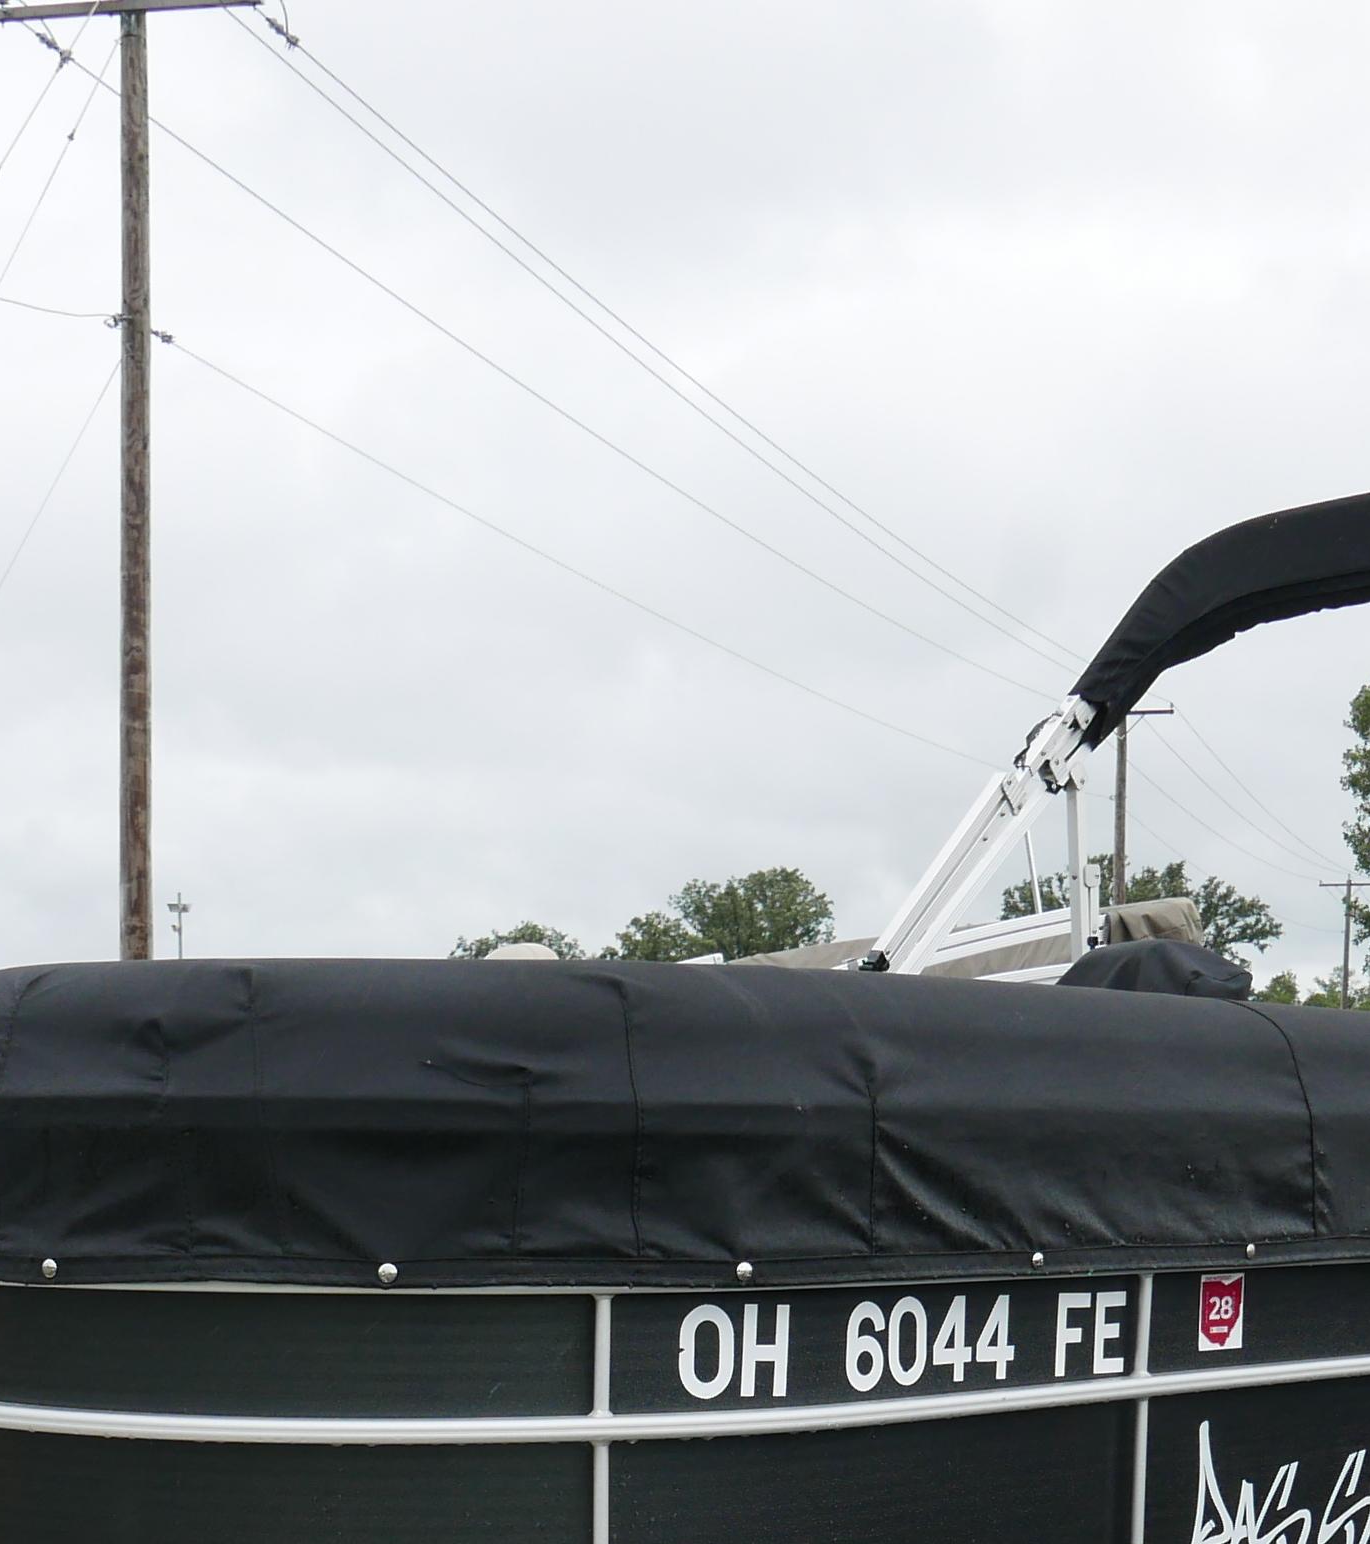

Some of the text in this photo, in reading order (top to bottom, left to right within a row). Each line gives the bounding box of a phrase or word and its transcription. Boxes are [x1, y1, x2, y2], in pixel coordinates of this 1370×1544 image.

[1209, 1296, 1233, 1320] 28
[678, 1291, 1126, 1399] OH 6044 FE
